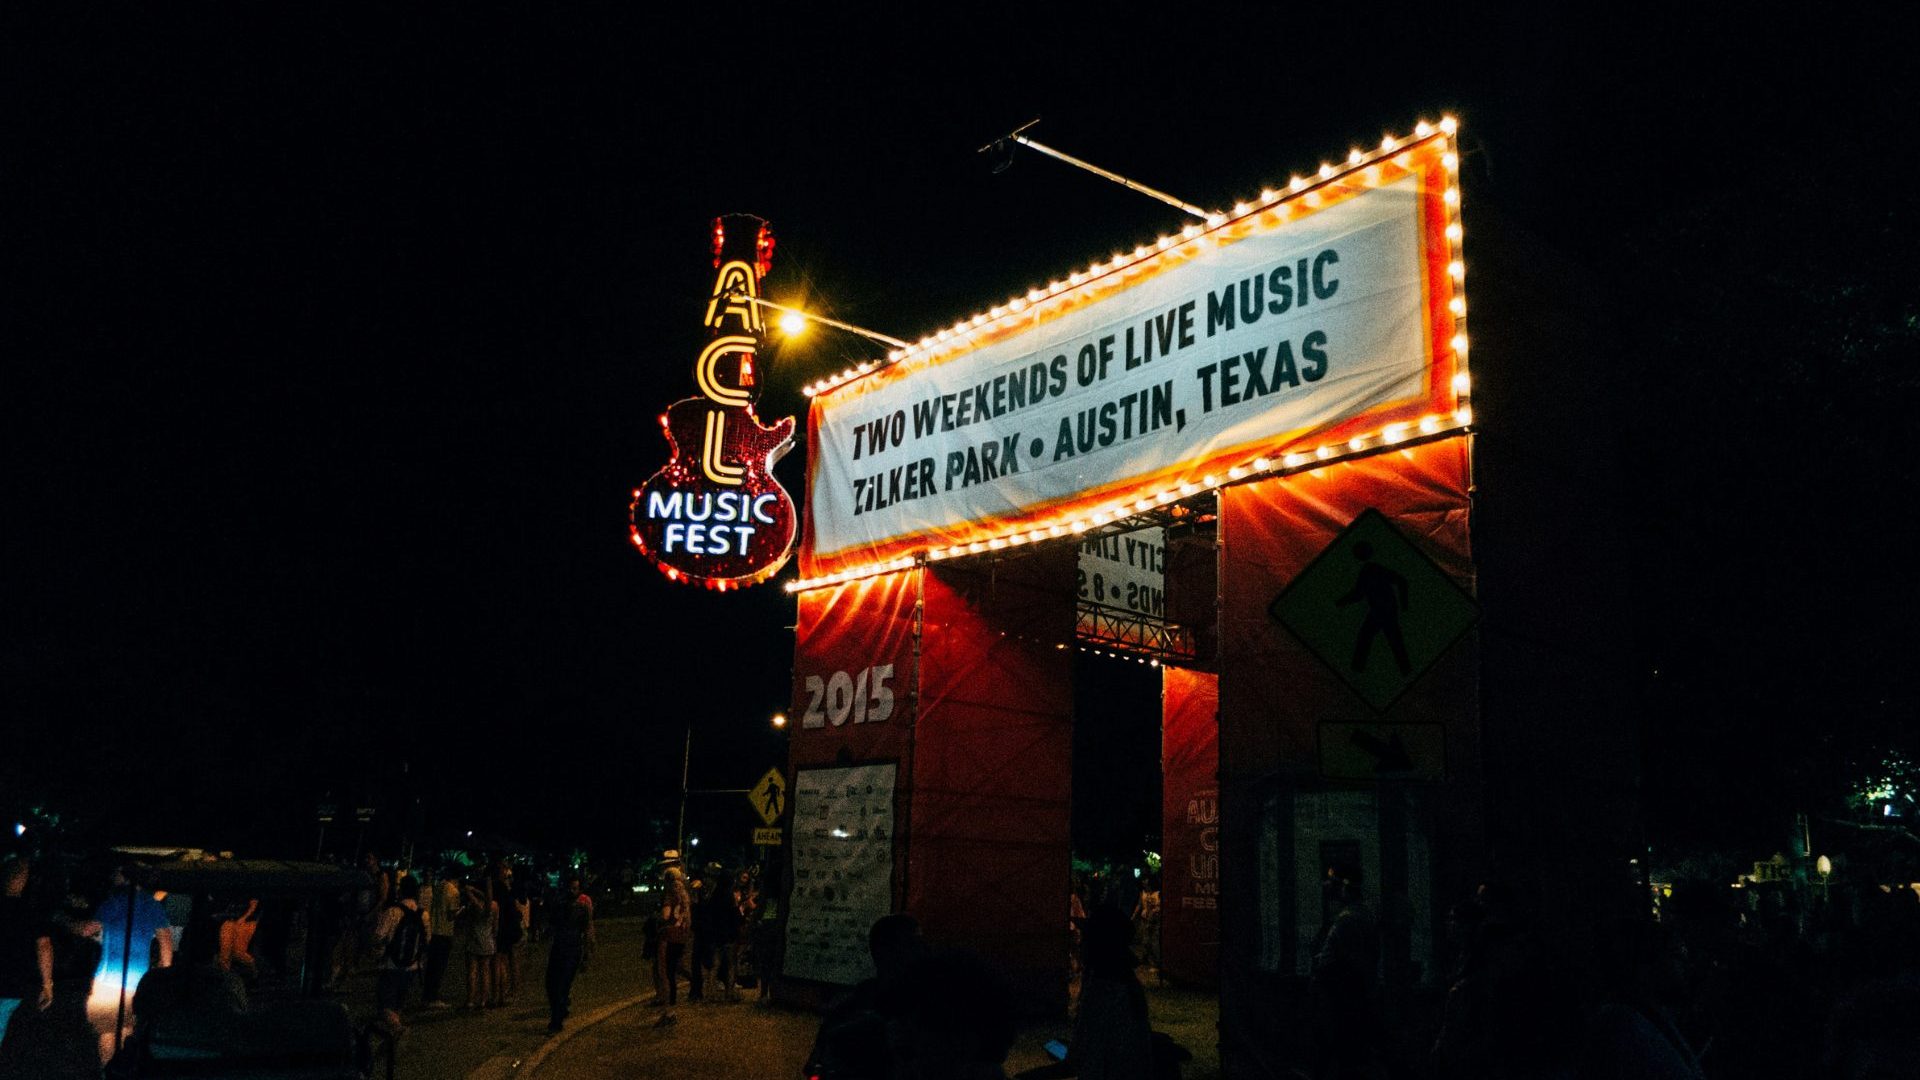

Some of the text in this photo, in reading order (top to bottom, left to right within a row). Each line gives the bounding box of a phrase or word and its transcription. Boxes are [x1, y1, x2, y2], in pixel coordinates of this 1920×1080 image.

[697, 261, 760, 485] ACL
[853, 248, 1340, 461] TWO WEEKENDS OF LIVE MUSIC
[853, 330, 1328, 516] ZILKER PARK AUSTIN, TEXAS
[648, 491, 778, 524] MUSIC
[665, 523, 756, 556] FEST
[802, 663, 895, 730] 2015
